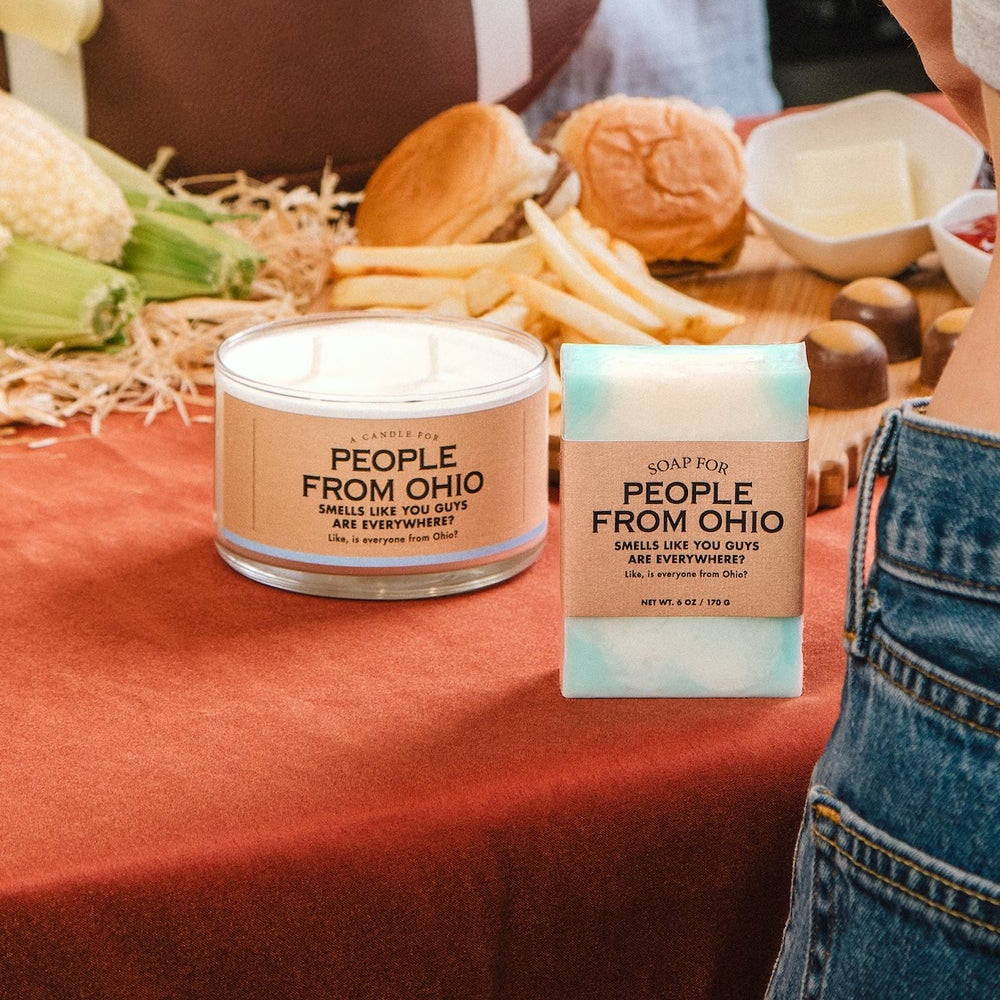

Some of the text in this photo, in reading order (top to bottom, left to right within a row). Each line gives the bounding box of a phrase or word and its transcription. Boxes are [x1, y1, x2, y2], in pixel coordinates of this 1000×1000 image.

[362, 430, 412, 441] CANDLE
[418, 431, 439, 442] FOR
[331, 444, 457, 472] PEOPLE
[647, 457, 729, 476] SOAP FOR
[302, 470, 484, 502] FROM OHIO
[623, 481, 753, 505] PEOPLE
[319, 500, 468, 516] SMELLS LIKE YOU GUYS
[332, 516, 454, 530] ARE EVERYWHERE?
[593, 510, 784, 533] FROM OHIO
[328, 530, 458, 545] Like, is everyone from Ohio?
[614, 541, 760, 551] SMELLS LIKE YOU GUYS
[628, 554, 745, 564] ARE EVERYWHERE?
[625, 570, 748, 580] Like, is everyone from Ohio?
